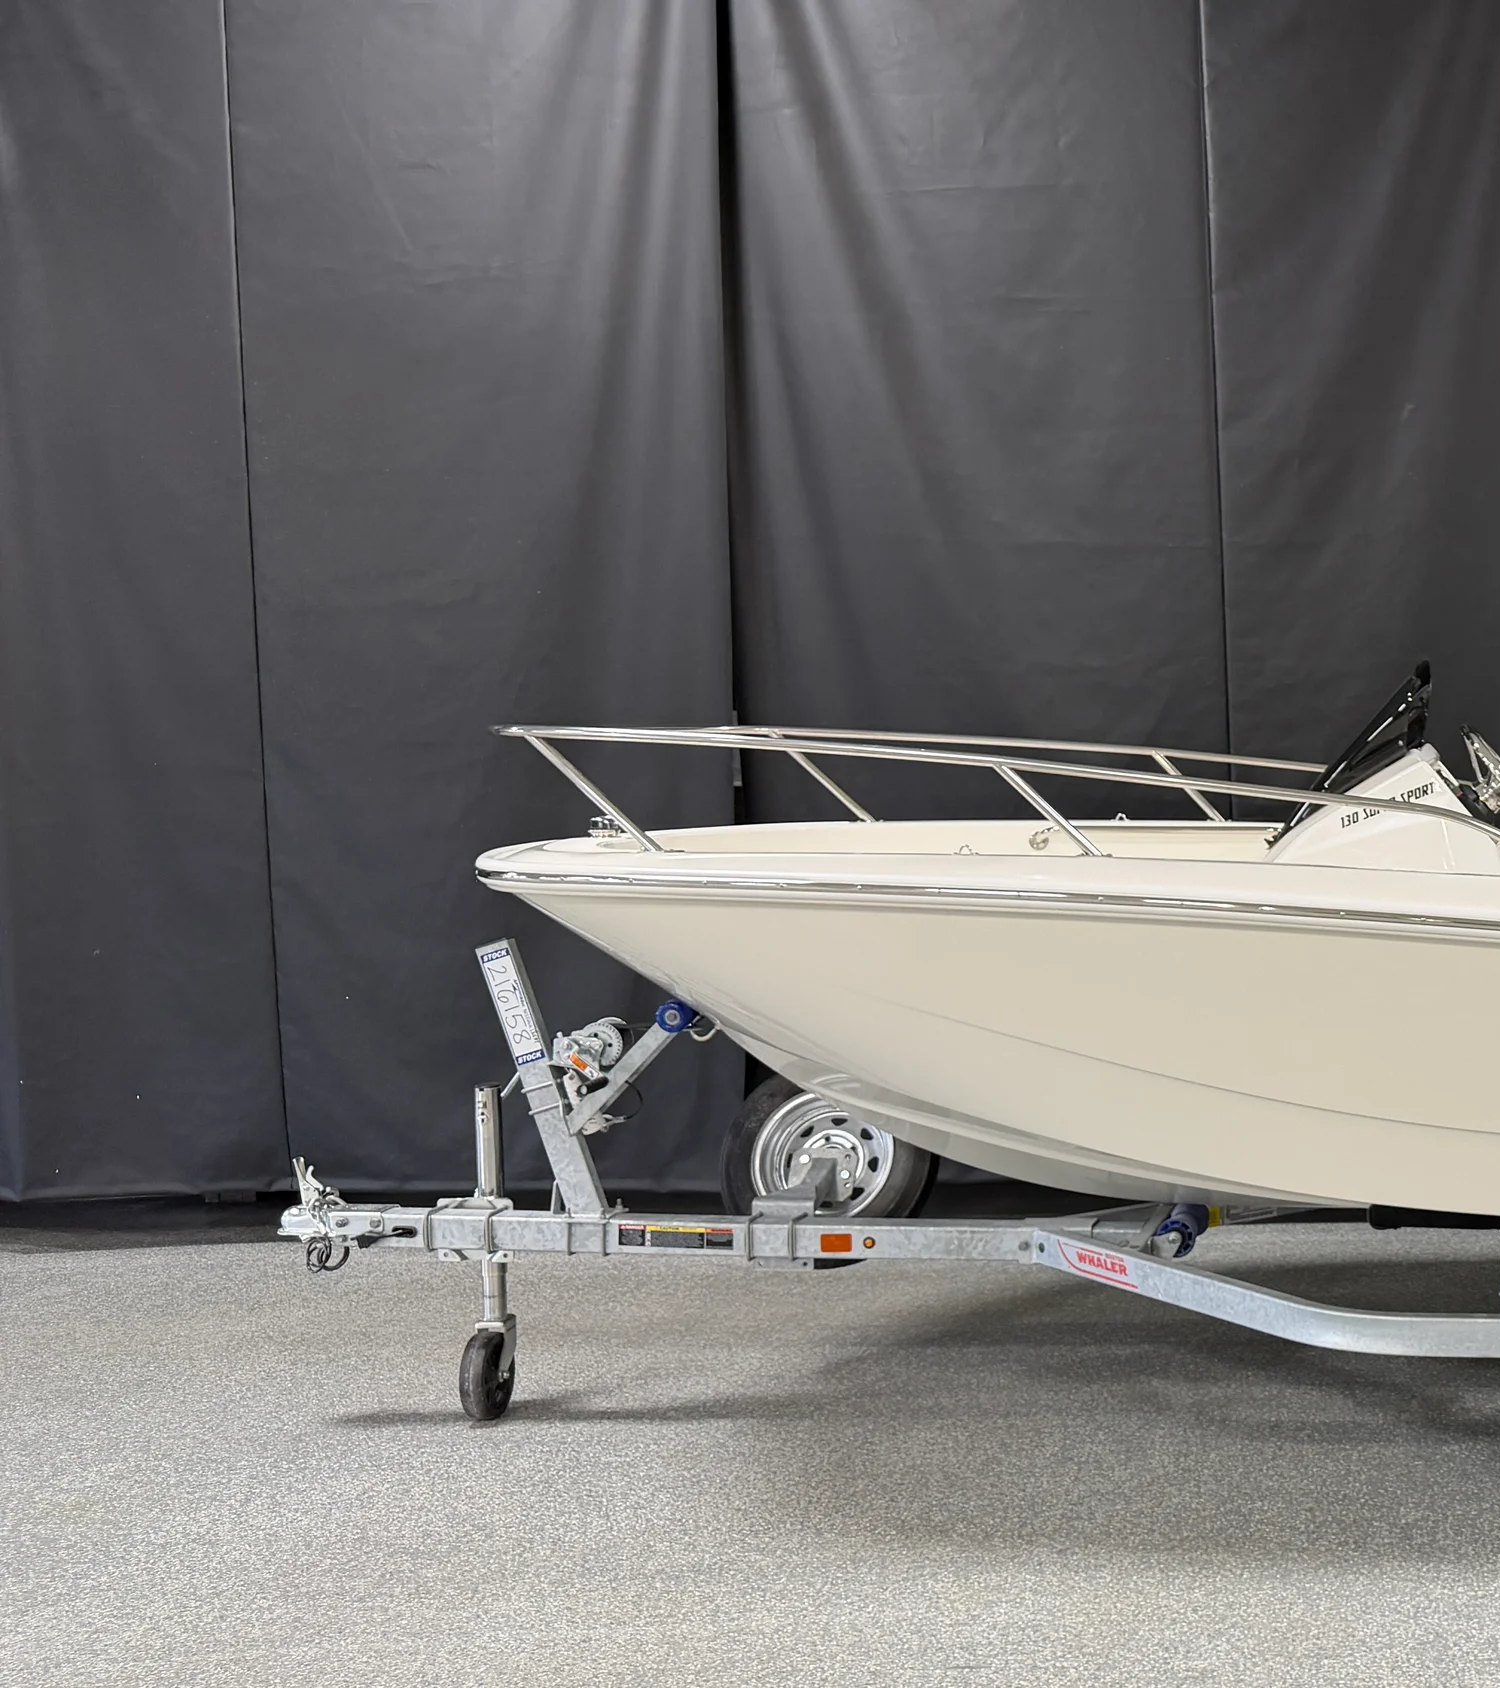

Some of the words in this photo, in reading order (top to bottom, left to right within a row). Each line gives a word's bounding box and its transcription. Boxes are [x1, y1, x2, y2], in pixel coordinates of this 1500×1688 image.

[1340, 811, 1359, 829] 130
[1400, 782, 1435, 803] SPORT
[482, 949, 508, 963] STOCK
[487, 965, 532, 1045] 216158
[517, 1051, 543, 1066] STOCK
[1076, 1250, 1129, 1277] WHALER
